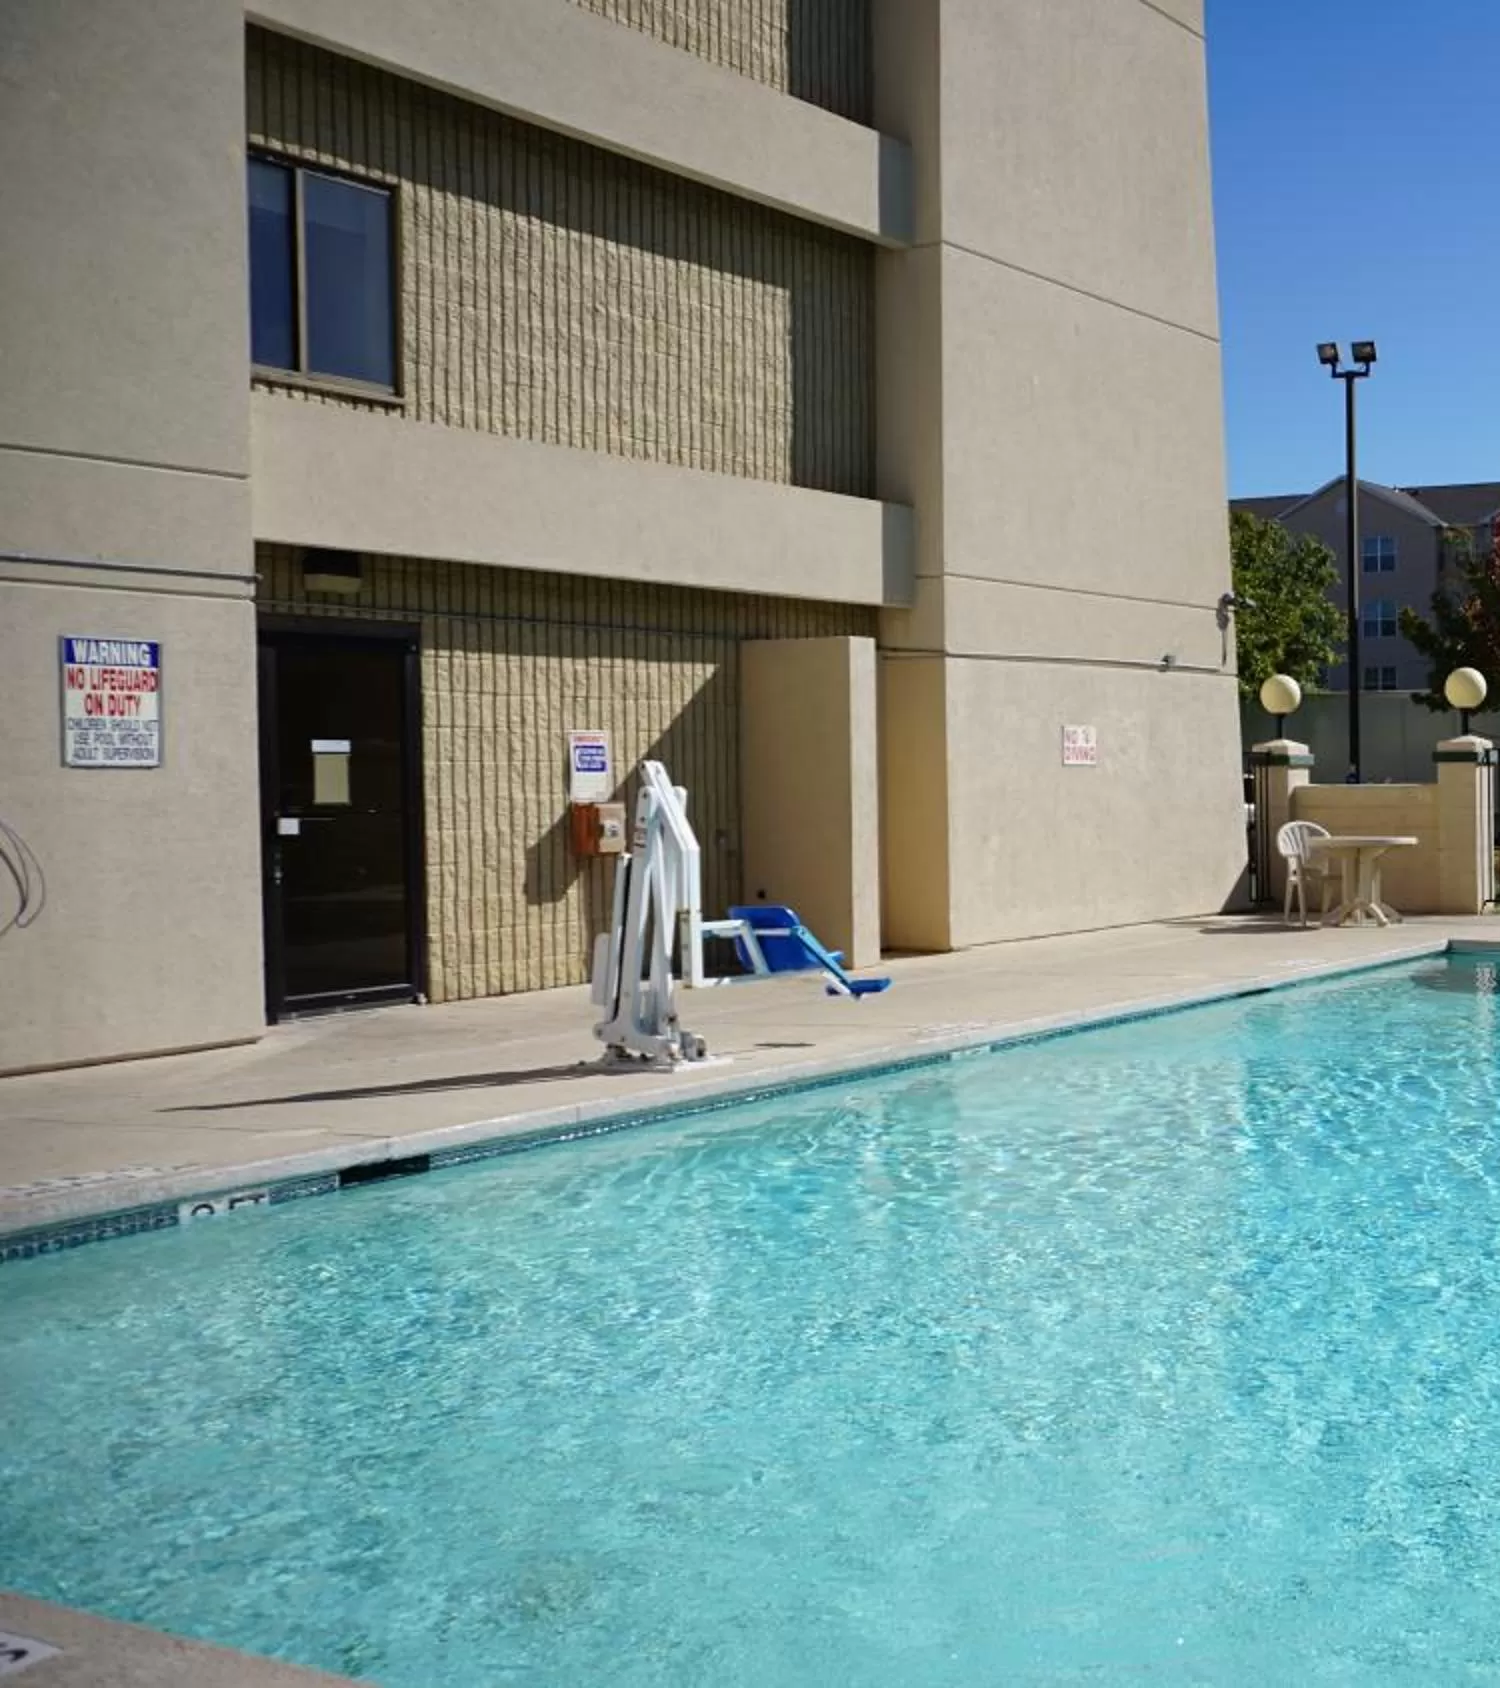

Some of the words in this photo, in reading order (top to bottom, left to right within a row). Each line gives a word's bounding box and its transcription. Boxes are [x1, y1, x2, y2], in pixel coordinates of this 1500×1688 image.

[72, 639, 151, 666] WARNING
[67, 667, 85, 690] NO
[90, 669, 159, 692] LIFEGUARD
[84, 693, 103, 716] ON
[108, 693, 141, 717] DUTY
